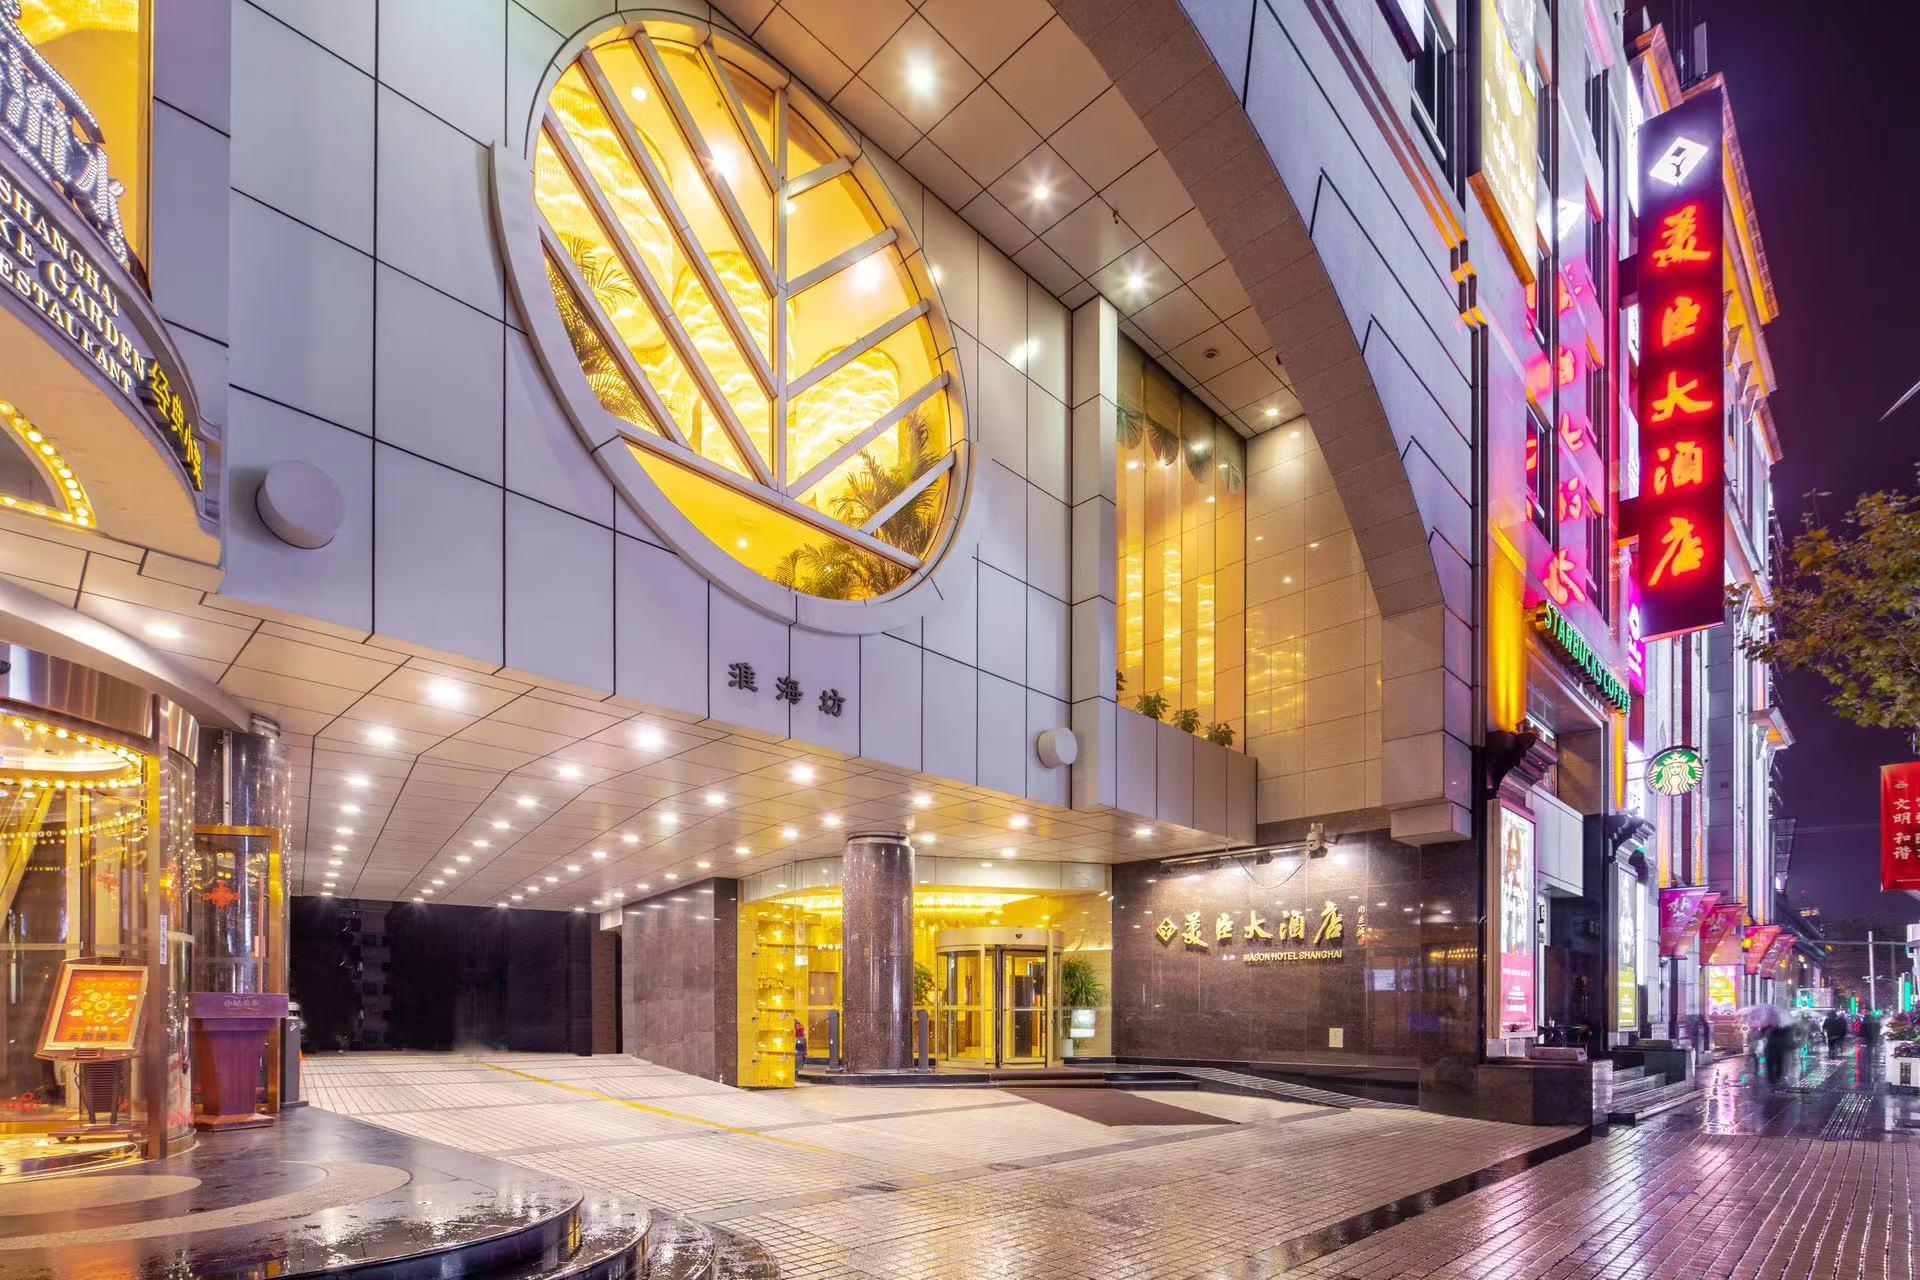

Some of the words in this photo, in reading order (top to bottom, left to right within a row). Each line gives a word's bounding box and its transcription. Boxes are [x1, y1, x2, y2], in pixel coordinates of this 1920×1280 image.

[0, 177, 119, 316] SHANGHAI
[48, 262, 146, 381] GARDEN
[728, 662, 846, 717] 淮海坊
[1545, 599, 1602, 685] STARBUCKS
[1603, 667, 1631, 717] COFFEE
[1242, 952, 1270, 962] MASON
[1270, 951, 1298, 961] HOTEL
[1299, 950, 1342, 960] SHANGHAI
